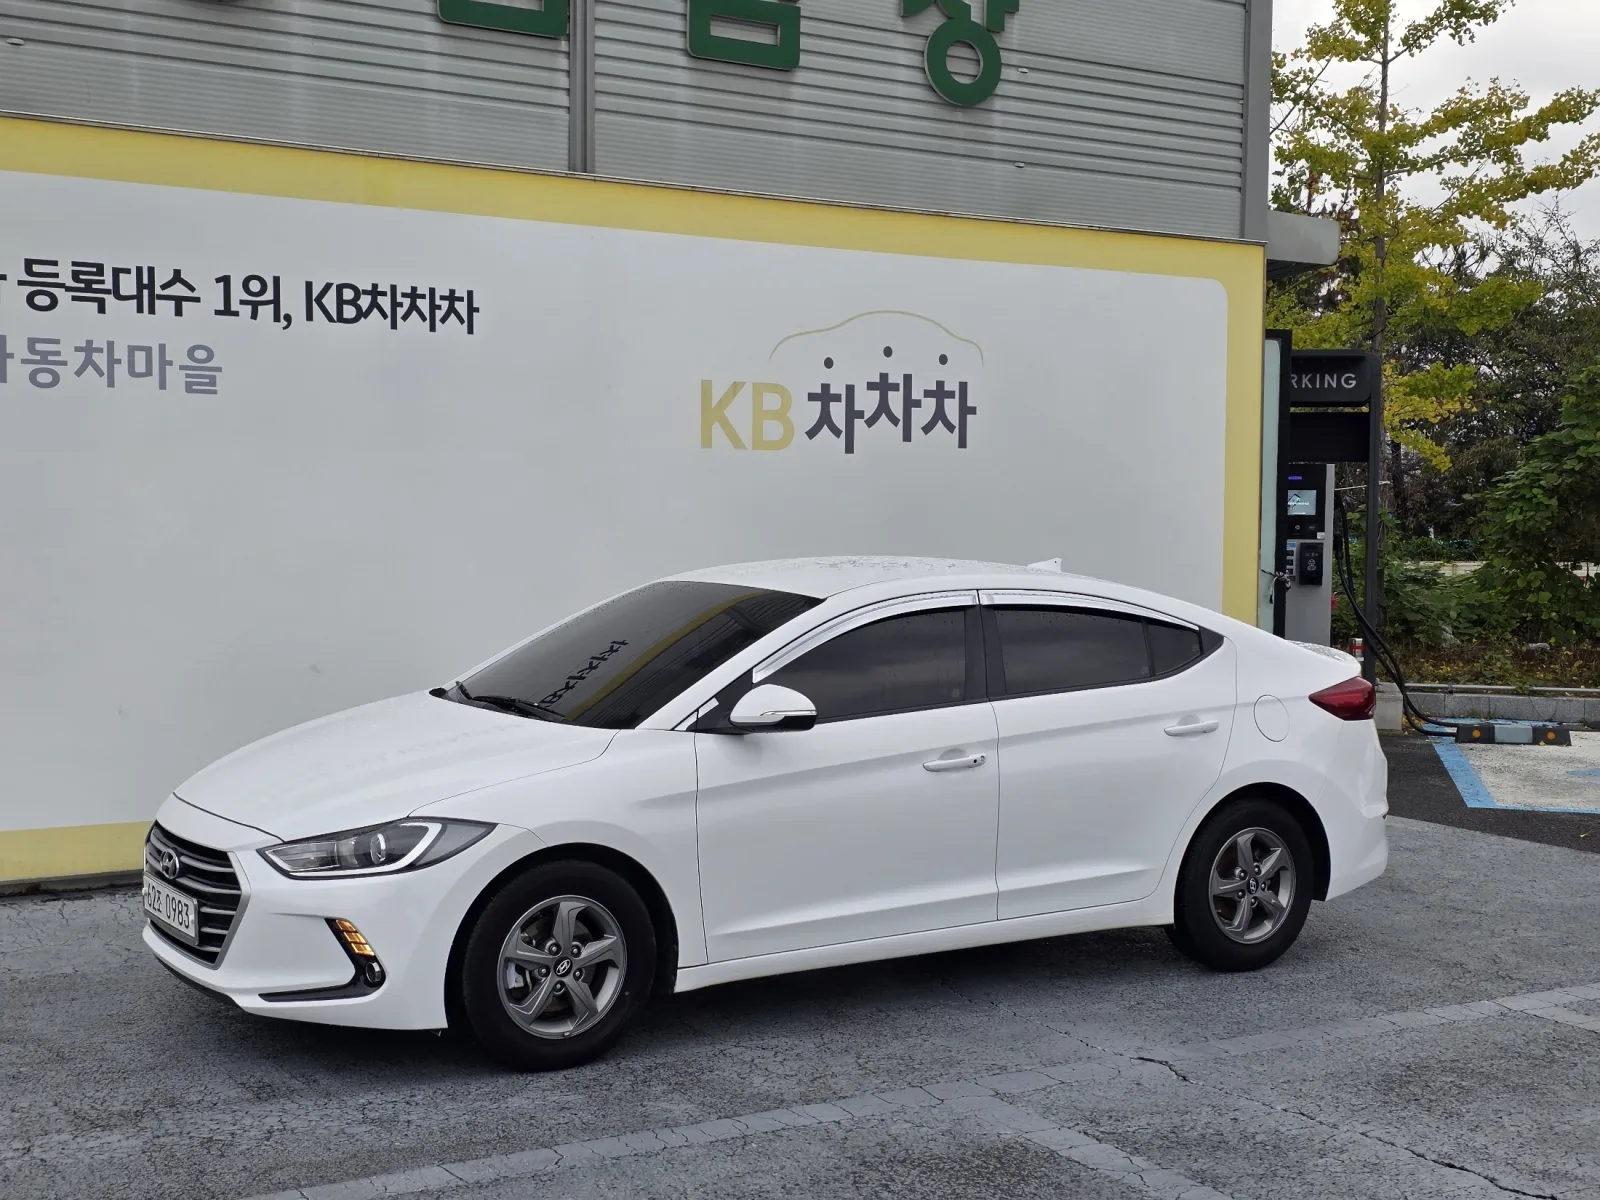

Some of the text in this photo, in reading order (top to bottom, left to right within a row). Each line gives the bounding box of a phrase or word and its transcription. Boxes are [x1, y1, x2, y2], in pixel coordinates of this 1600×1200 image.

[17, 257, 480, 335] 등록대수 1위, KB차차차
[165, 893, 190, 929] 0983
